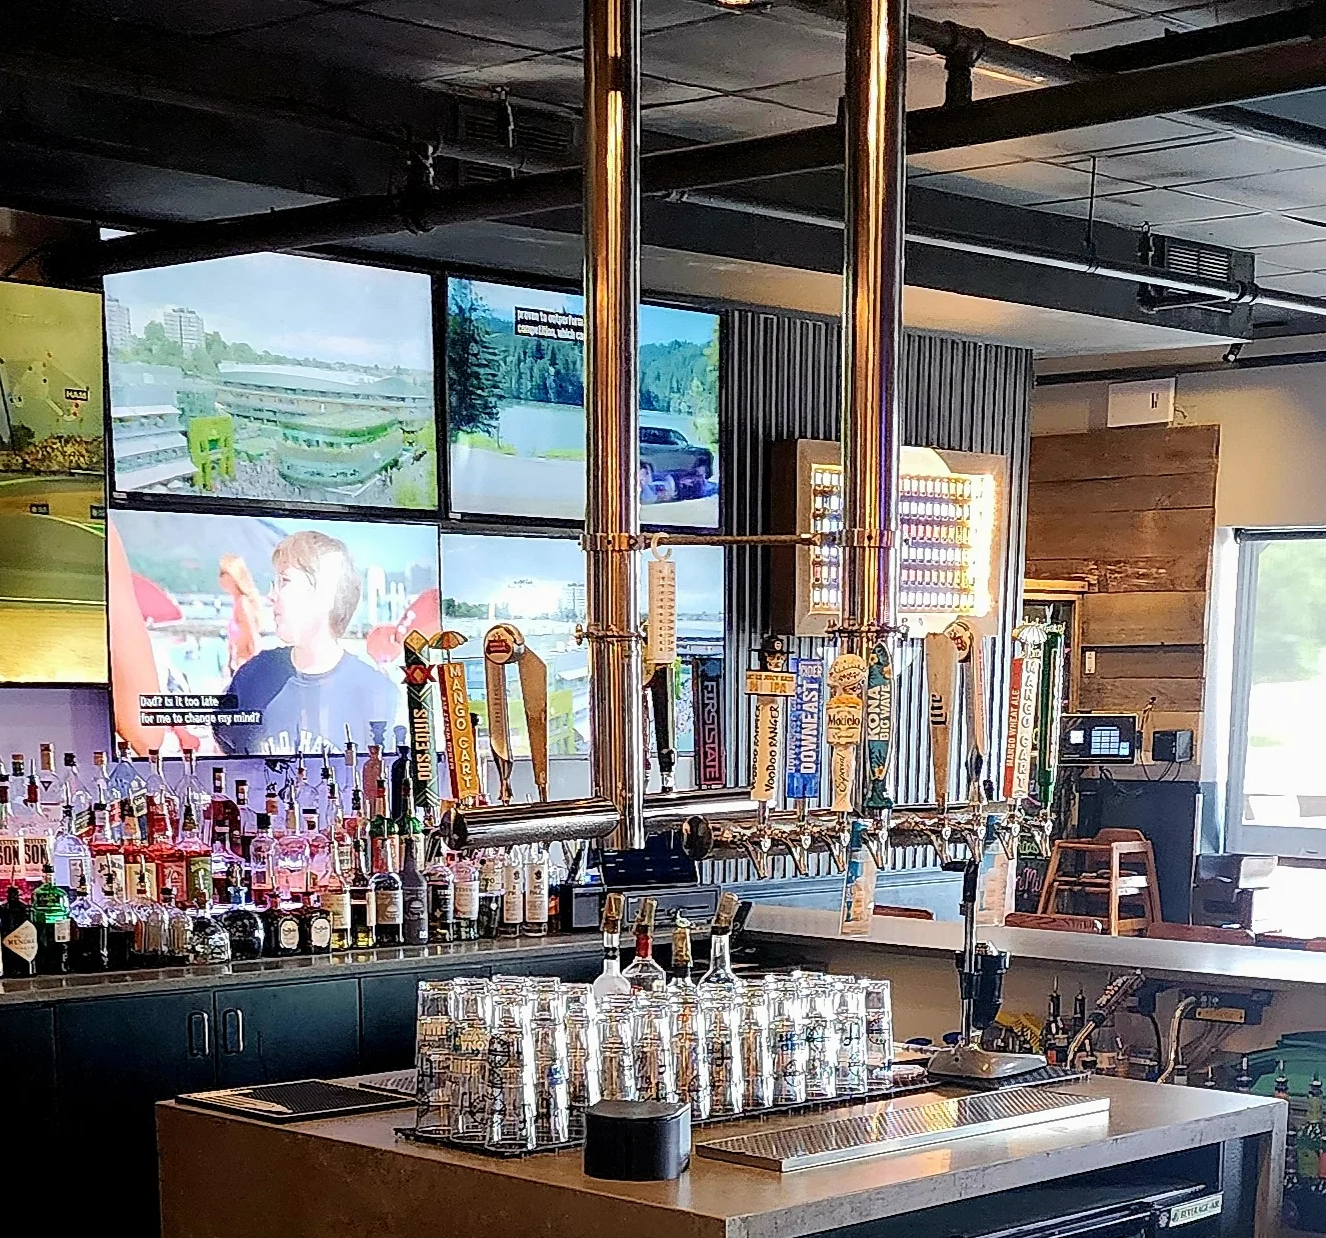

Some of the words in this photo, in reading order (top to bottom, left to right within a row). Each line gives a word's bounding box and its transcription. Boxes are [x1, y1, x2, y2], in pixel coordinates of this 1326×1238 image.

[140, 695, 163, 707] Dad?
[175, 695, 183, 707] it
[185, 696, 200, 707] too
[201, 695, 220, 707] late
[449, 666, 467, 730] MANGO
[867, 684, 881, 740] KONA
[879, 684, 891, 718] WAVE
[1012, 689, 1020, 709] ALE
[140, 713, 155, 724] for
[156, 714, 172, 724] me
[172, 713, 183, 724] to
[185, 712, 216, 726] change
[218, 714, 232, 726] my
[233, 712, 260, 723] mind?
[414, 708, 431, 752] EQUIS
[768, 705, 780, 748] RANGER
[800, 681, 819, 774] DOWNEAST
[828, 714, 860, 726] Modelo
[879, 719, 890, 741] BIG
[1009, 709, 1019, 736] WHEAT
[458, 738, 472, 788] CART
[1006, 738, 1015, 767] MANGO
[417, 754, 432, 781] DOS
[25, 844, 48, 865] SON
